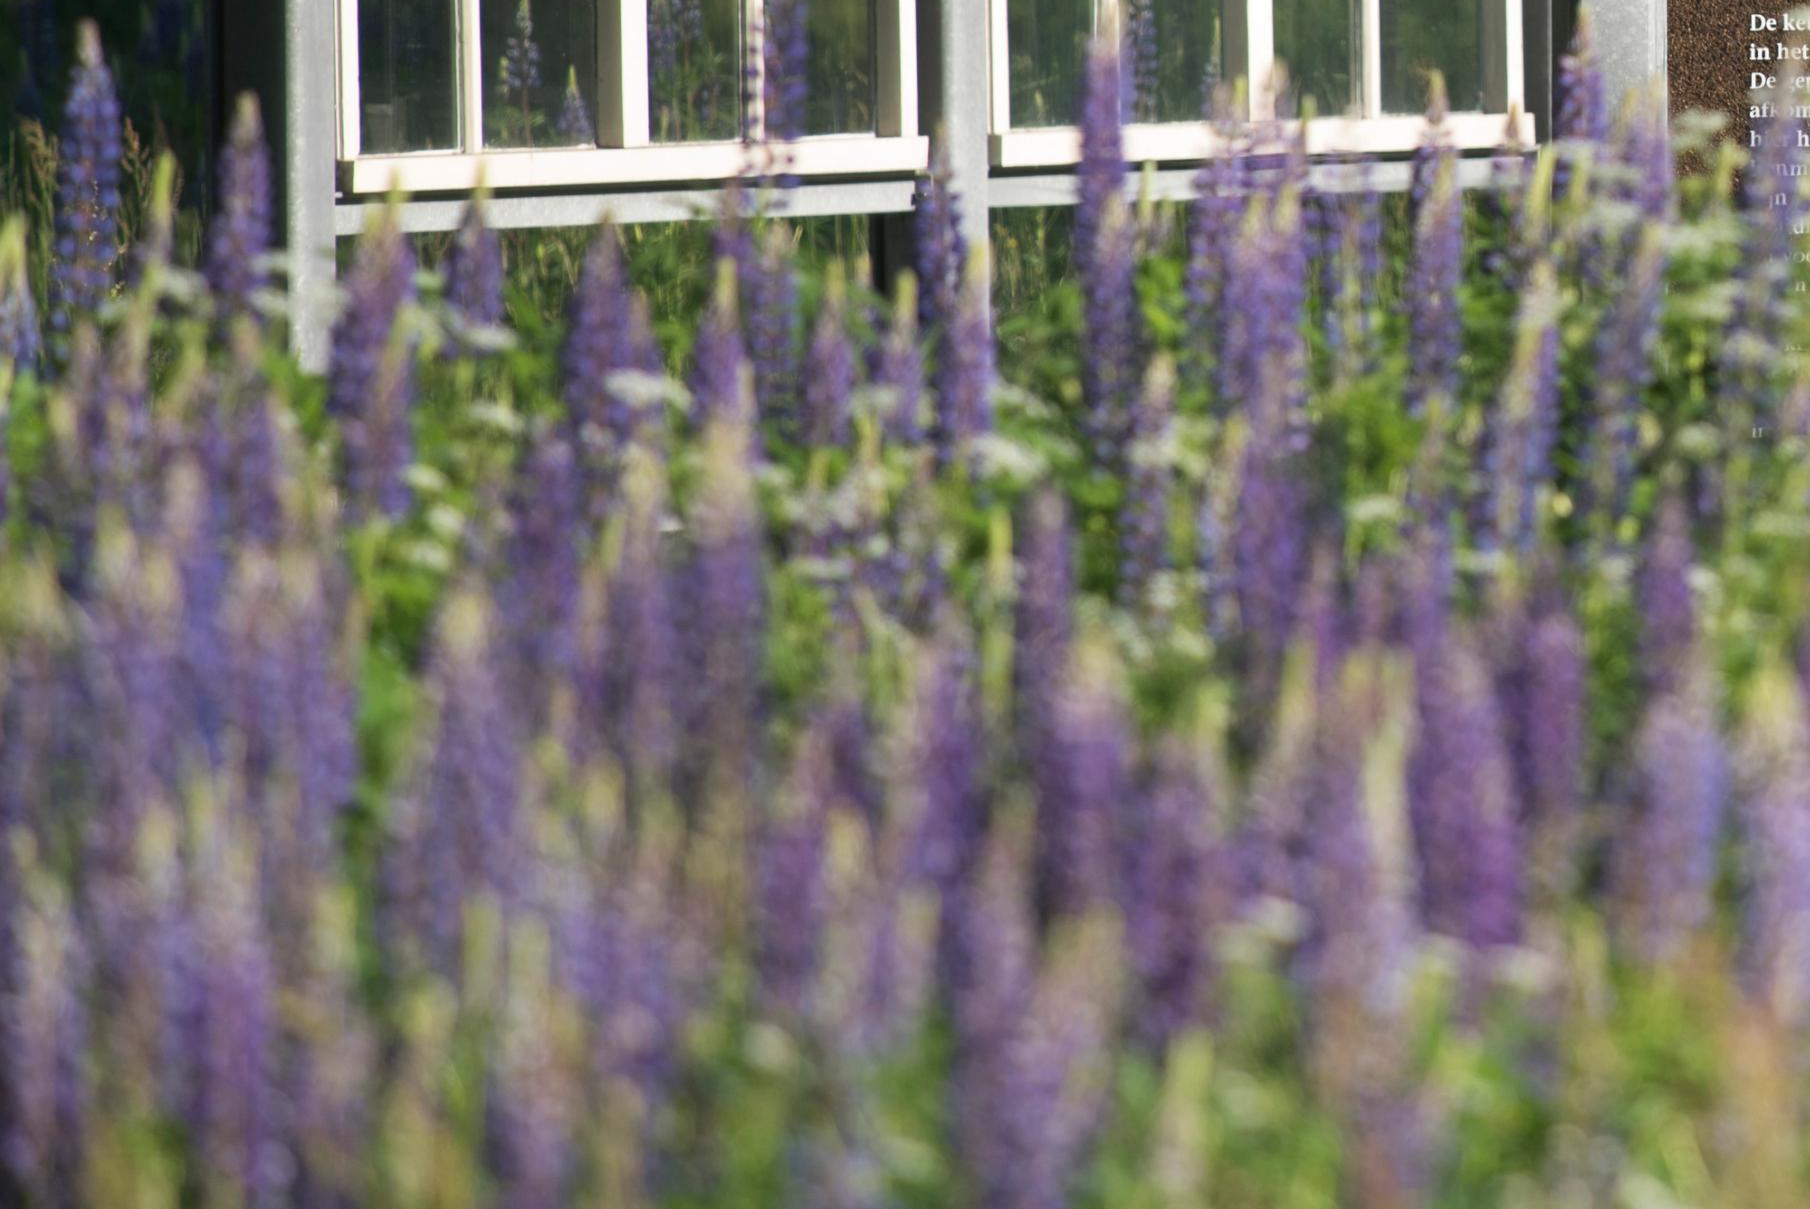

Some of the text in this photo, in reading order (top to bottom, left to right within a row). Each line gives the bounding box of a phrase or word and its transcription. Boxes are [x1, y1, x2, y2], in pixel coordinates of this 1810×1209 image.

[1750, 13, 1777, 31] De
[1750, 42, 1771, 61] in
[1777, 42, 1810, 60] het
[1750, 71, 1777, 90] De
